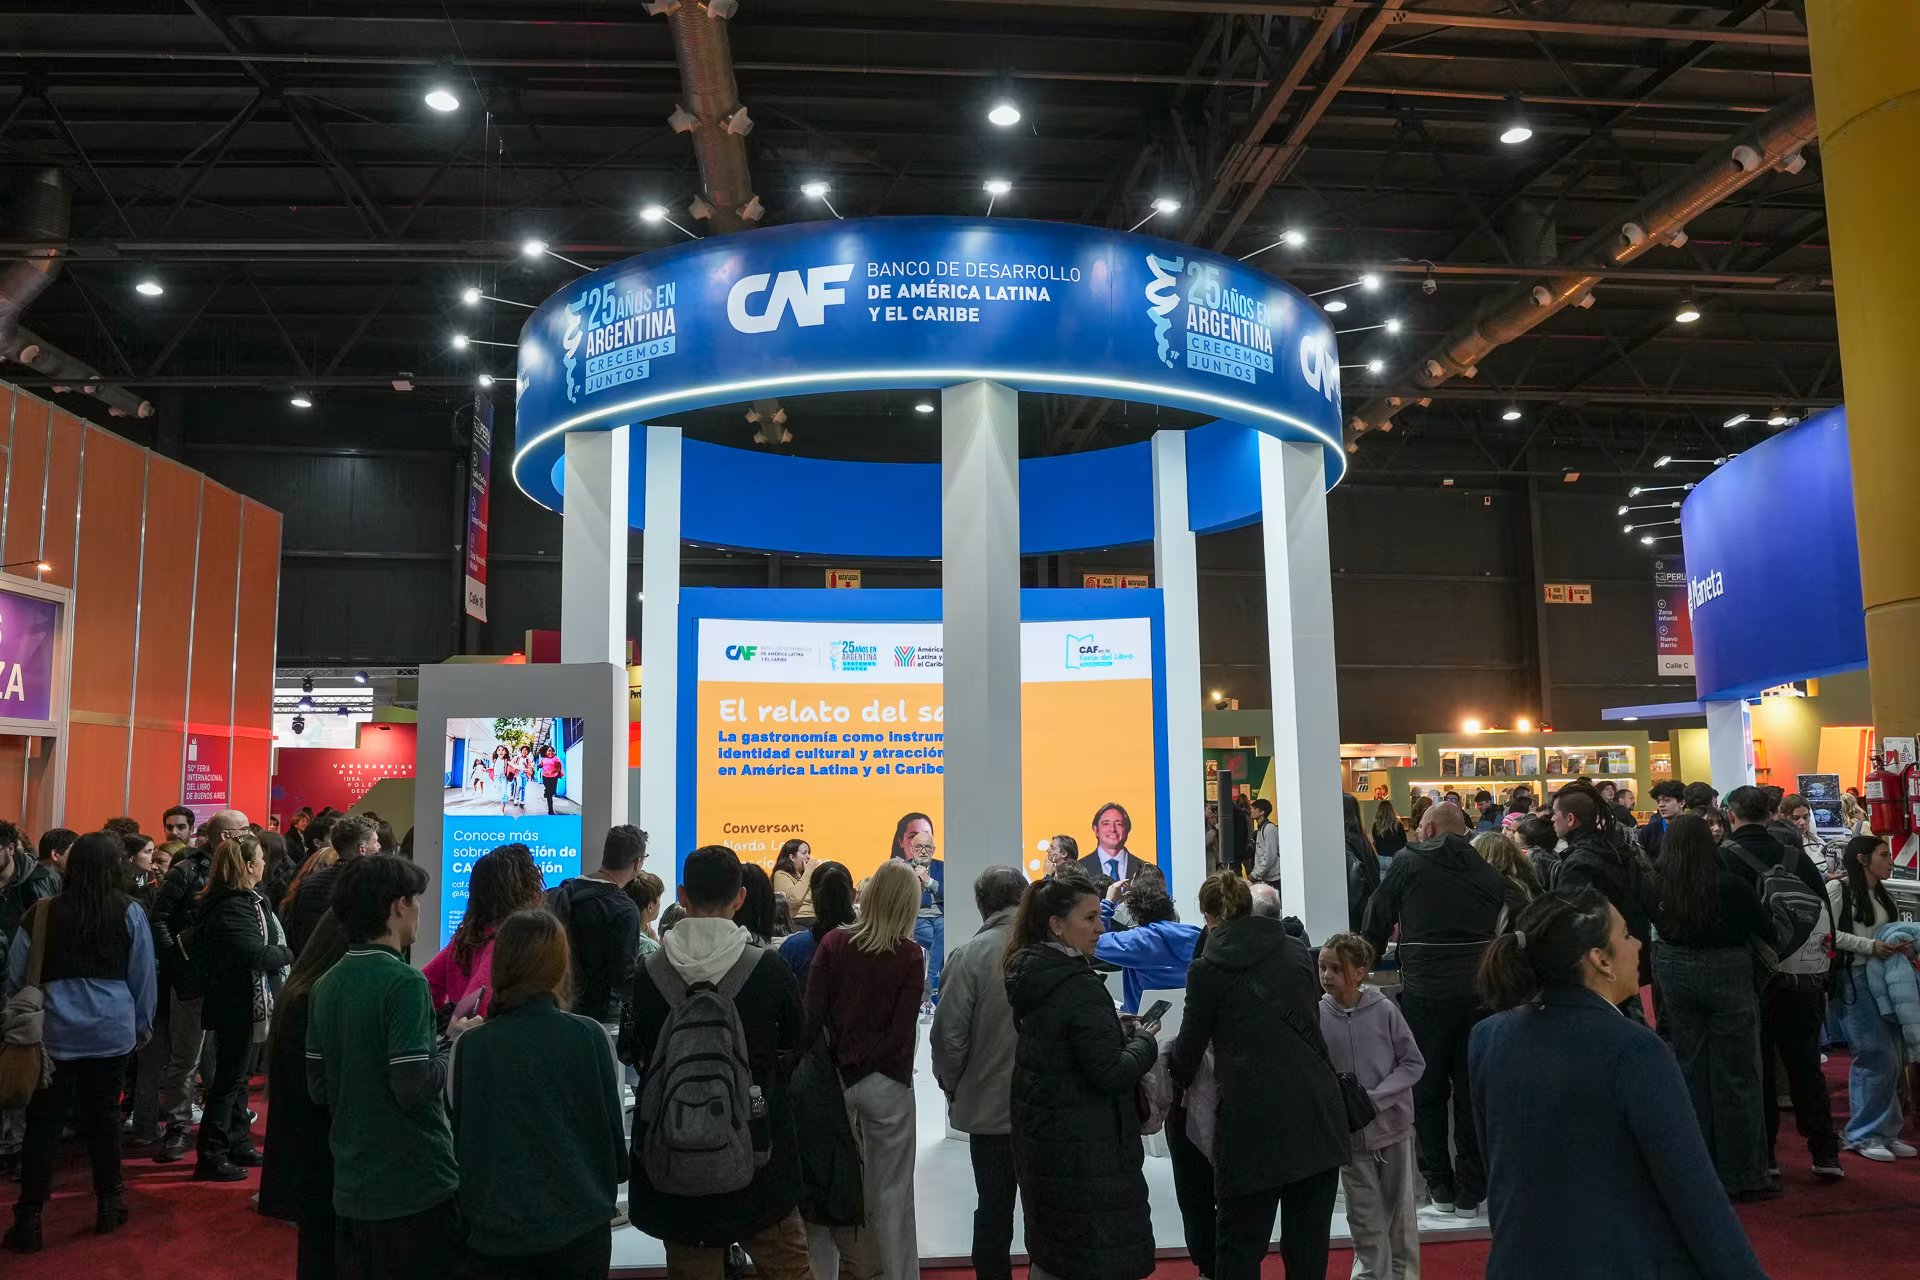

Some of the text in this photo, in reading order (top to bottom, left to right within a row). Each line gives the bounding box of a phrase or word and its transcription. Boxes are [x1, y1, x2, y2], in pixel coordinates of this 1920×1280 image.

[867, 261, 1081, 282] BANCO DE DESARROLLO
[727, 263, 855, 333] CAF
[867, 279, 1051, 301] DE AMÉRICA LATINA
[1187, 261, 1271, 327] 25 AÑOS EN
[587, 281, 676, 331] 25 AÑOS EN
[869, 306, 980, 322] Y EL CARIBE
[585, 308, 676, 358] ARGENTINA
[1186, 304, 1273, 355] ARGENTINA
[589, 341, 670, 373] CRECEMOS
[1191, 337, 1270, 370] CRECEMOS
[588, 365, 644, 391] JUNTOS
[1191, 355, 1251, 380] JUNTOS
[1692, 569, 1724, 609] Planeta
[725, 645, 758, 661] CAF
[842, 641, 854, 653] 25
[1079, 645, 1098, 653] CAF
[719, 698, 748, 722] El
[758, 698, 850, 722] relato
[861, 698, 908, 722] del
[718, 731, 737, 742] La
[741, 731, 838, 745] gastronomía
[842, 733, 884, 742] como
[718, 747, 944, 761] identidad cultural y atracción
[187, 774, 223, 782] INTERNACIONAL
[197, 764, 210, 772] FERIA
[718, 763, 944, 777] en América Latina y el Caribe
[453, 829, 539, 841] Conoce más
[723, 822, 804, 834] Conversan:
[453, 846, 491, 857] sobre
[559, 846, 577, 857] de
